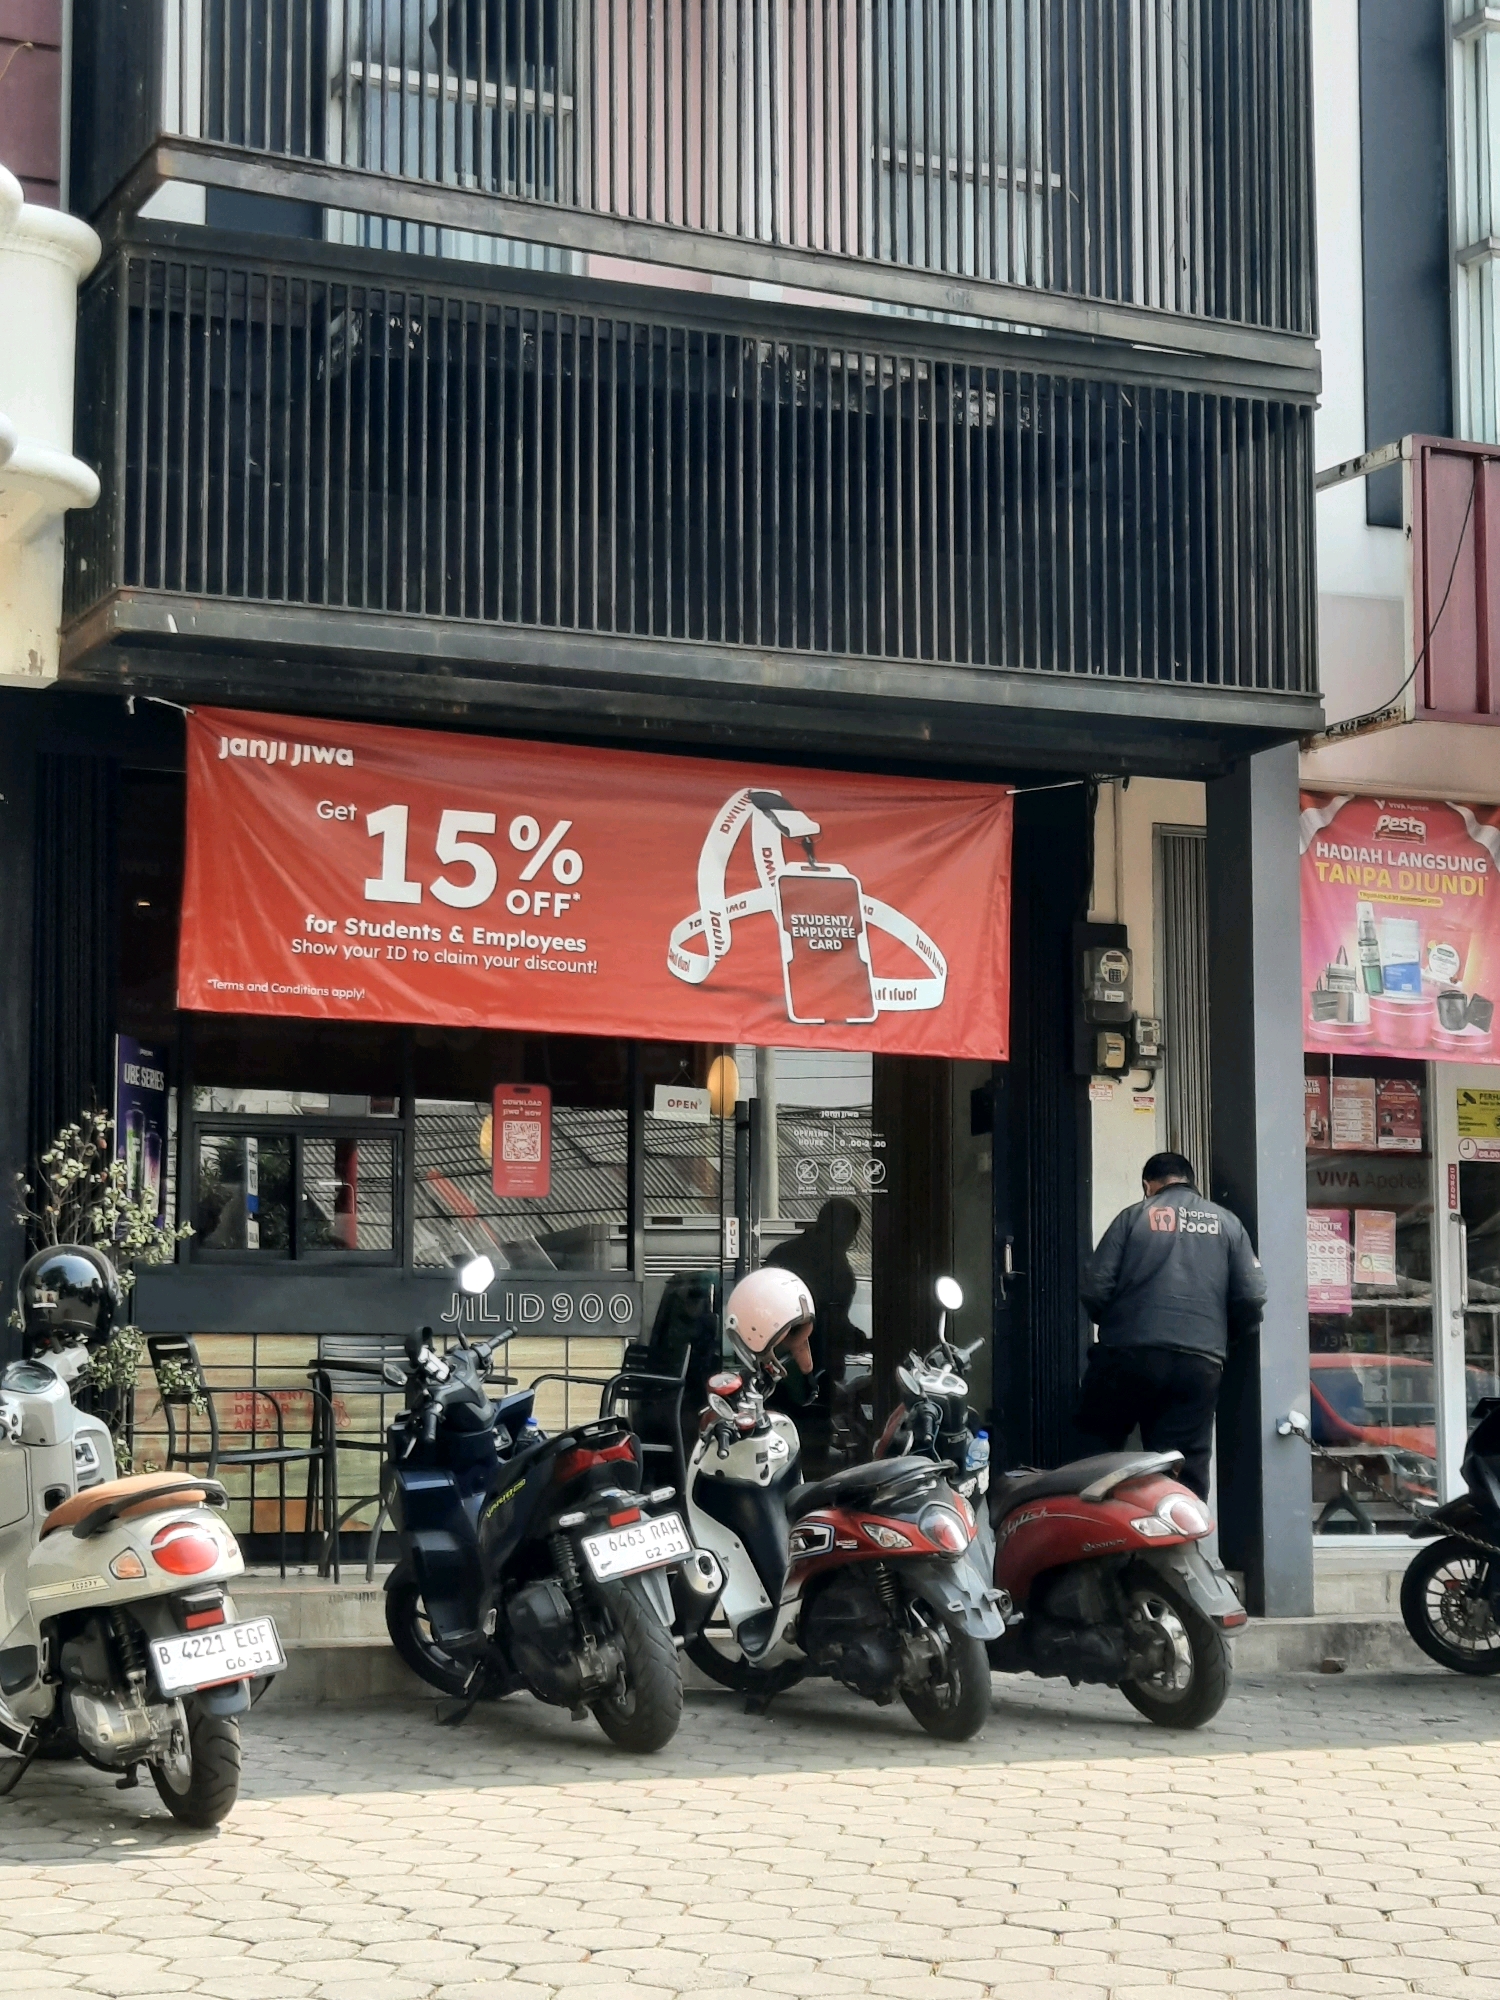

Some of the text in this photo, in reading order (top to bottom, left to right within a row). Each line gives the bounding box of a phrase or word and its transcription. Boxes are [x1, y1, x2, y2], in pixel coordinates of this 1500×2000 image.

[316, 800, 583, 910] Get 15%
[1316, 842, 1488, 874] HADIAH LANGSUNG
[1315, 861, 1393, 889] TANPA
[791, 914, 854, 928] STUDENT/
[792, 926, 856, 939] EMPLOYEE
[305, 914, 587, 954] for Students & Employees
[809, 938, 842, 951] CARD
[291, 939, 597, 974] Show your ID to claim your discount!
[247, 982, 269, 993] and
[271, 983, 330, 997] Conditions
[332, 987, 365, 1001] apply!
[668, 1098, 698, 1110] OPEN
[1317, 1171, 1428, 1191] VIVA Apotek
[1180, 1218, 1219, 1235] Food
[589, 1519, 681, 1557] B 6463 RAH
[159, 1624, 267, 1665] B 4221 EGF
